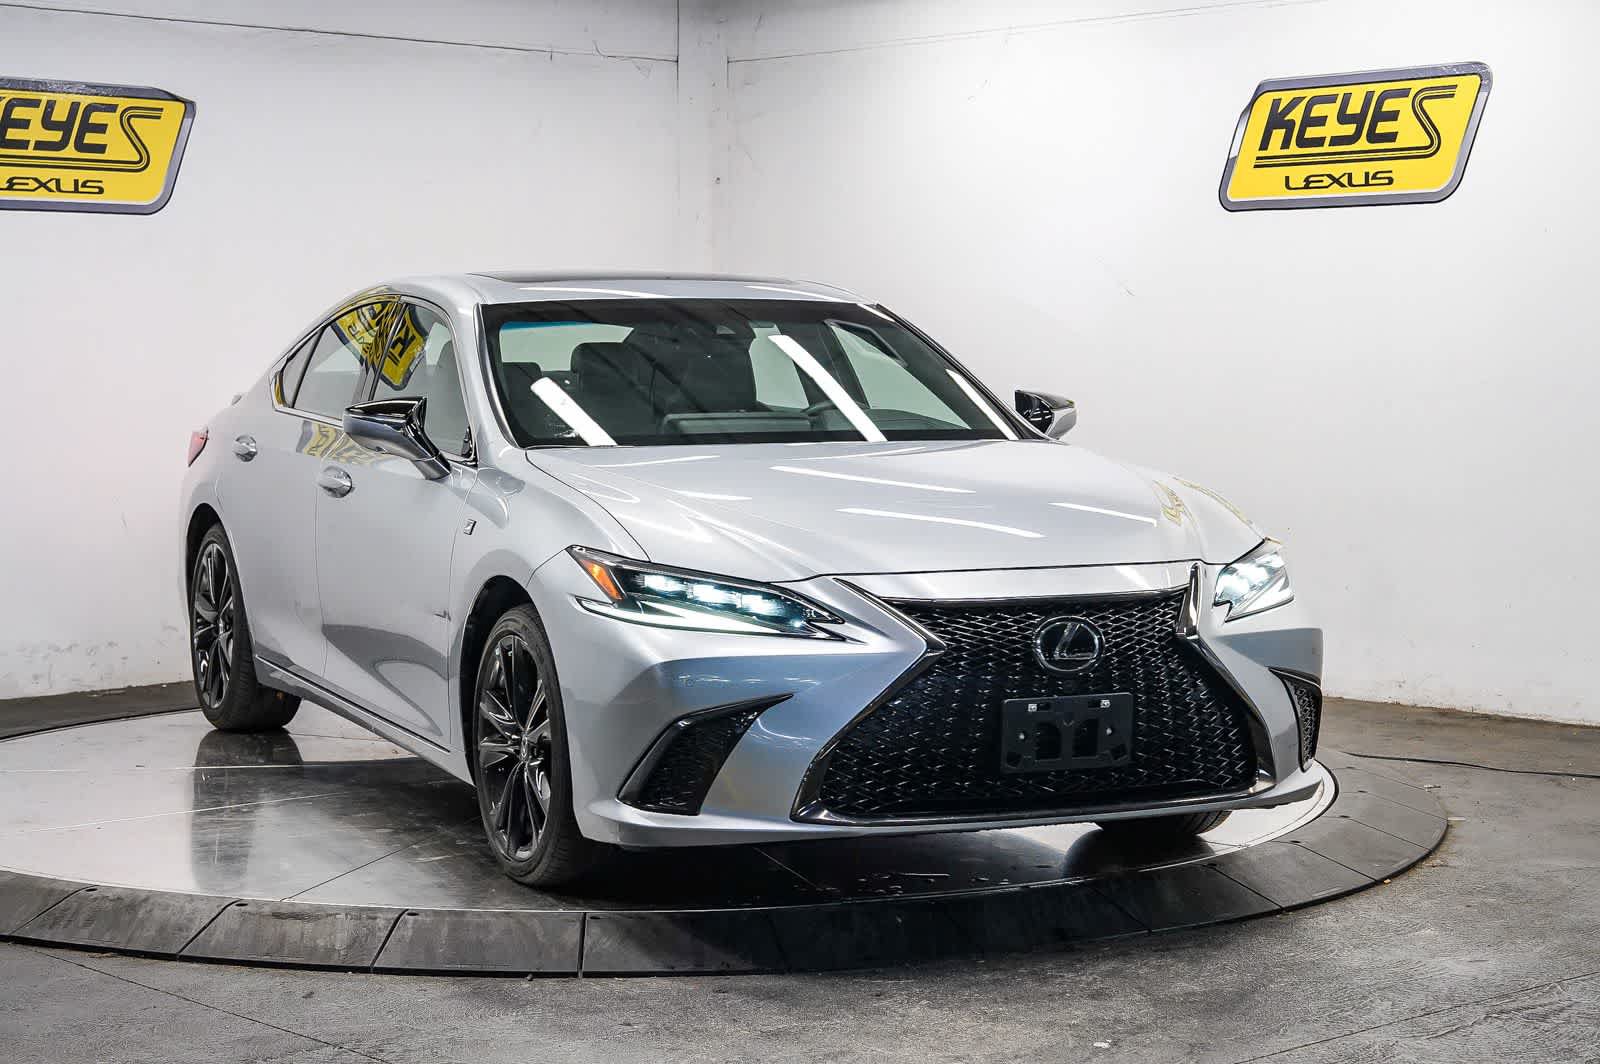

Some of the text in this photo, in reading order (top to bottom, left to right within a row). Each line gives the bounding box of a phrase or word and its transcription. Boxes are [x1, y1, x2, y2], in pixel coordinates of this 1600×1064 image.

[0, 96, 164, 172] EYES
[1258, 84, 1458, 161] KEYES
[1285, 170, 1395, 191] LEXUS
